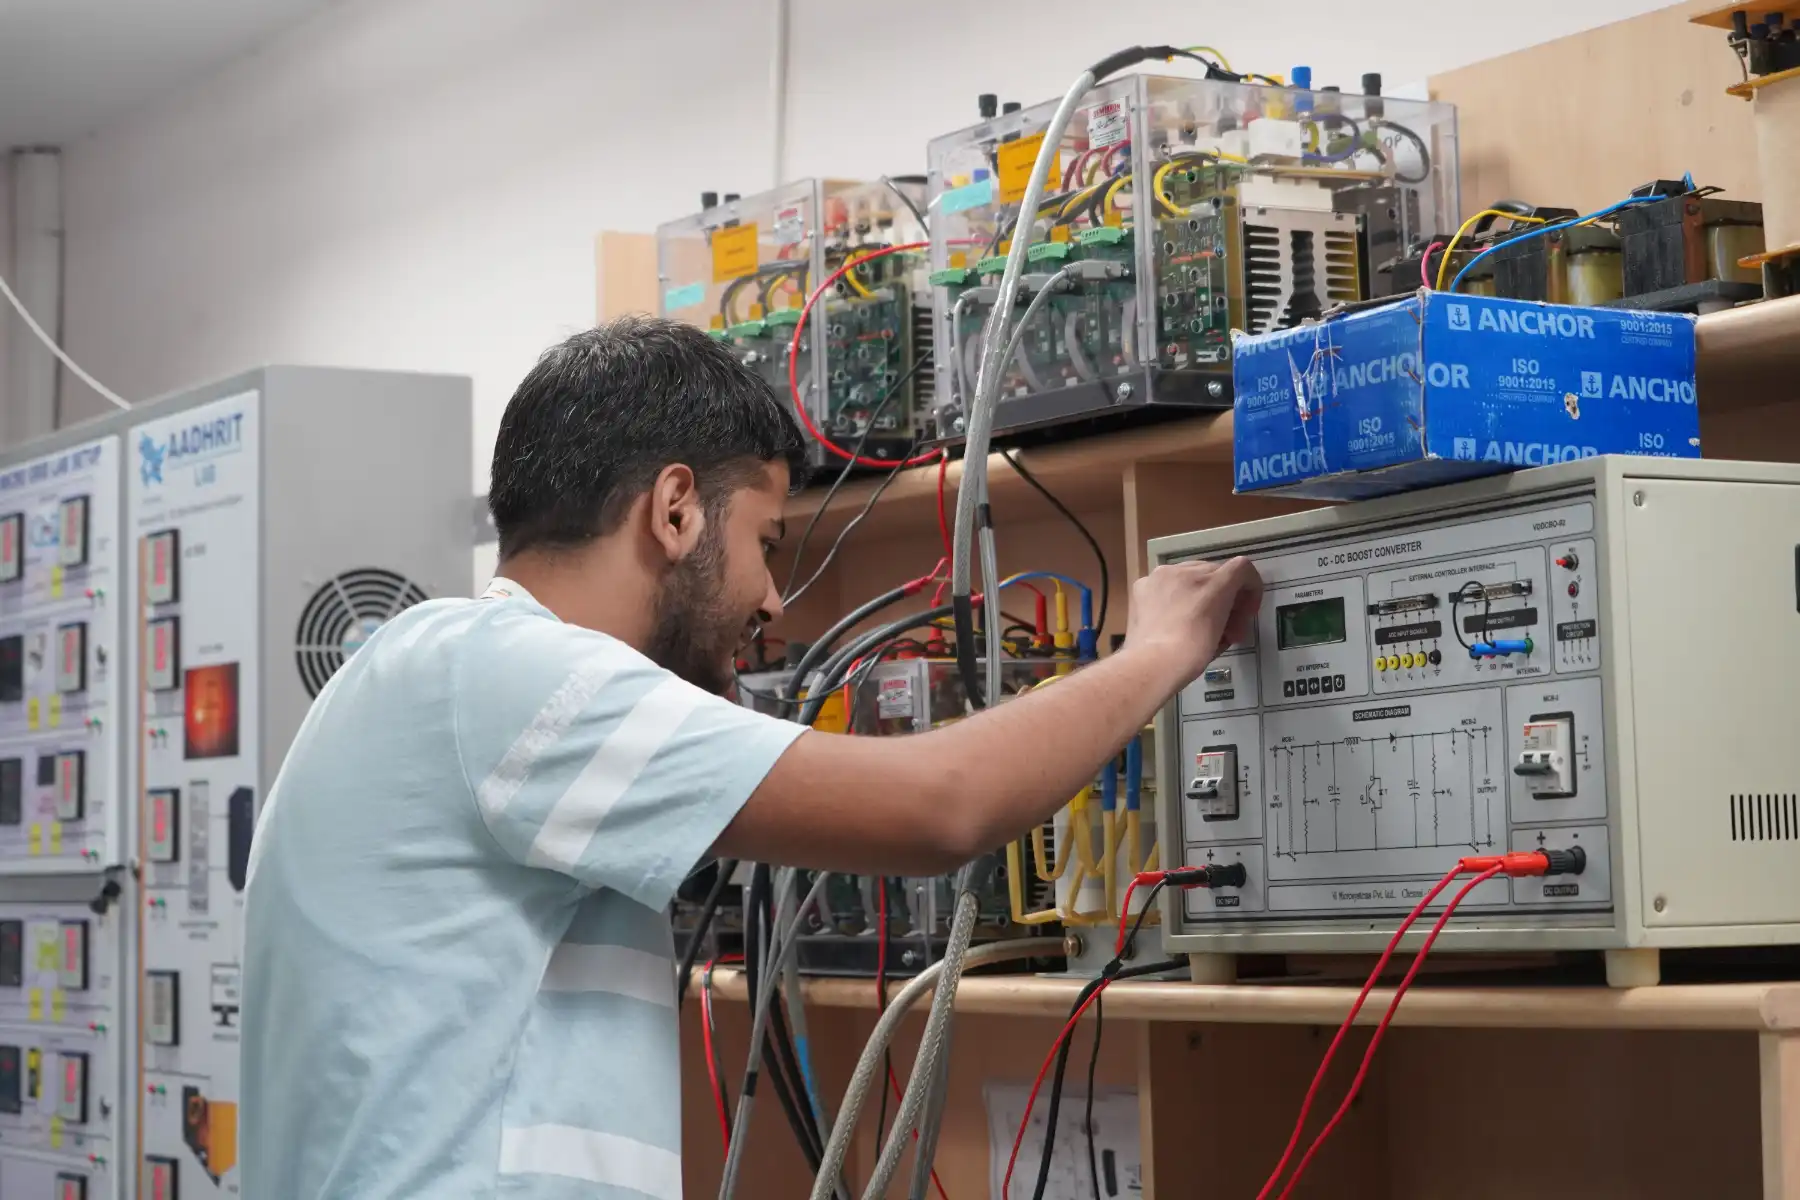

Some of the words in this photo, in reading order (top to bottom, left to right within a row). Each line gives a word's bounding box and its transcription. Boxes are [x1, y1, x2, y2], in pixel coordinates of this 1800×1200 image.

[1478, 307, 1596, 339] ANCHOR
[1620, 319, 1673, 335] 9001:2015
[1512, 358, 1540, 375] ISO
[1257, 374, 1278, 393] ISO
[1427, 362, 1471, 389] OR
[1498, 375, 1556, 391] 9001:2015
[1247, 388, 1289, 407] 9001:2015
[1608, 375, 1695, 405] ANCHO
[1358, 416, 1382, 435] ISO
[167, 413, 244, 458] AADHRIT
[1348, 432, 1395, 451] 9001:2015
[1639, 433, 1665, 449] ISO
[1239, 446, 1325, 485] ANCHOR
[1317, 555, 1330, 568] DC
[1334, 552, 1346, 565] DC
[1347, 548, 1373, 563] BOOST
[1374, 540, 1423, 558] CONVERTER
[1409, 569, 1434, 582] EXTERNAL
[1434, 565, 1468, 578] CONTROLLER
[1468, 562, 1496, 575] INTERFACE
[1294, 589, 1324, 599] PARAMETERS
[1409, 627, 1428, 636] SIGNALS
[1561, 621, 1591, 632] PROTECTION
[1565, 629, 1584, 638] CIRCUIT
[1305, 662, 1330, 671] INTERFACE
[1516, 667, 1541, 676] INTERNAL
[1354, 709, 1384, 720] SCHEMATIC
[1384, 706, 1410, 717] DIAGRAM
[1477, 786, 1498, 794] OUTPUT
[1544, 886, 1553, 895] DC
[1554, 885, 1578, 894] OUTPUT
